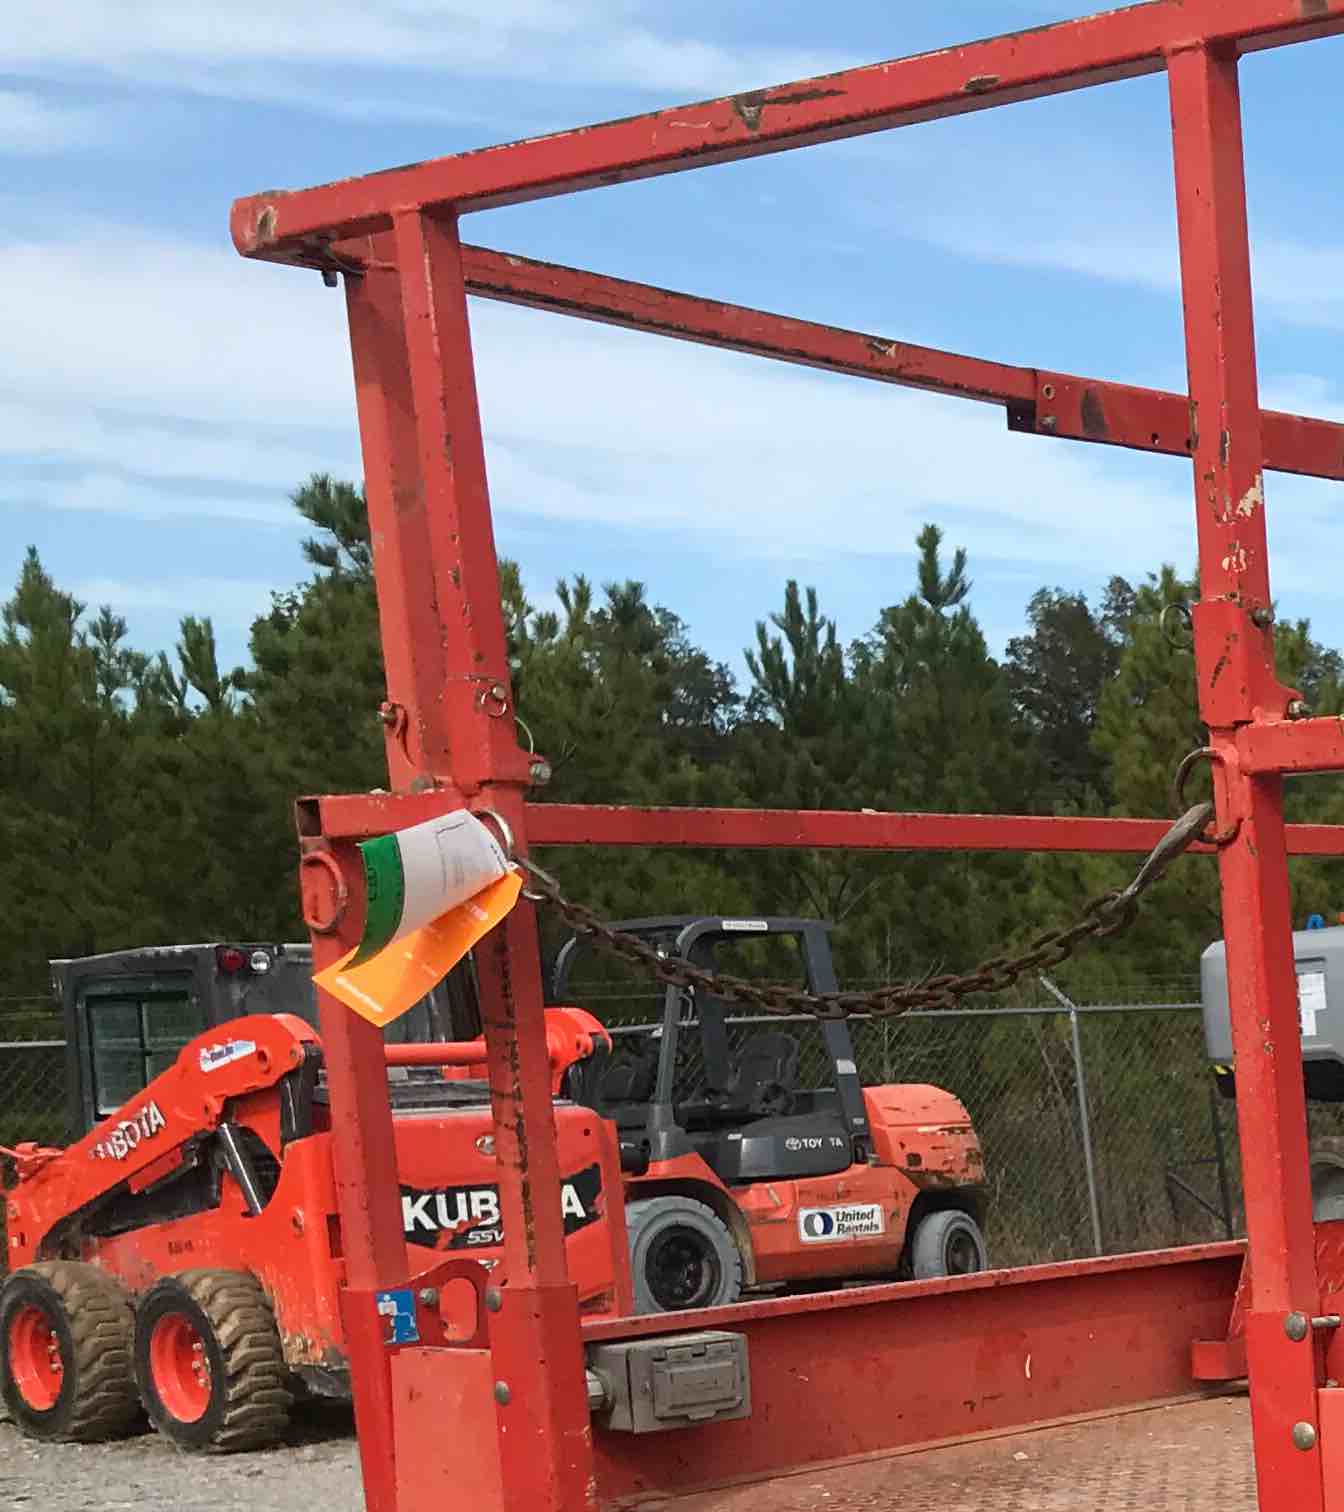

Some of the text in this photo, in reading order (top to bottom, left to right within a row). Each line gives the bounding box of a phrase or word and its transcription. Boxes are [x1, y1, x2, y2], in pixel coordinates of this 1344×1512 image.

[803, 1136, 843, 1149] TOYTA
[401, 1184, 586, 1232] KUBA
[836, 1208, 875, 1222] United
[837, 1221, 880, 1234] Rentals
